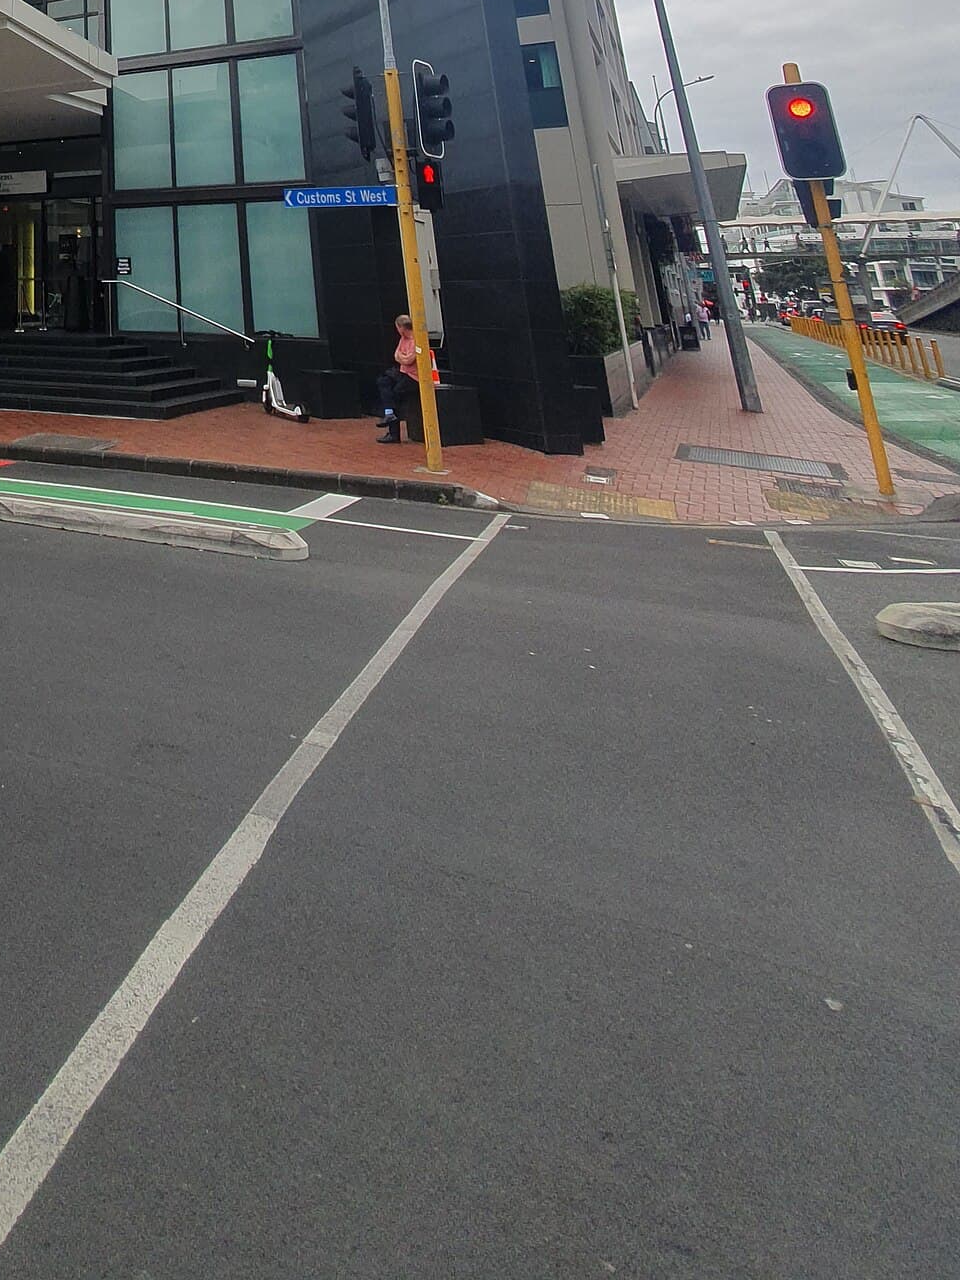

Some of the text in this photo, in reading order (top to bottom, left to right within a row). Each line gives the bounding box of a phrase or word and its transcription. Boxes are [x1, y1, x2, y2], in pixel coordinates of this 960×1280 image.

[296, 189, 387, 205] Customs St West
